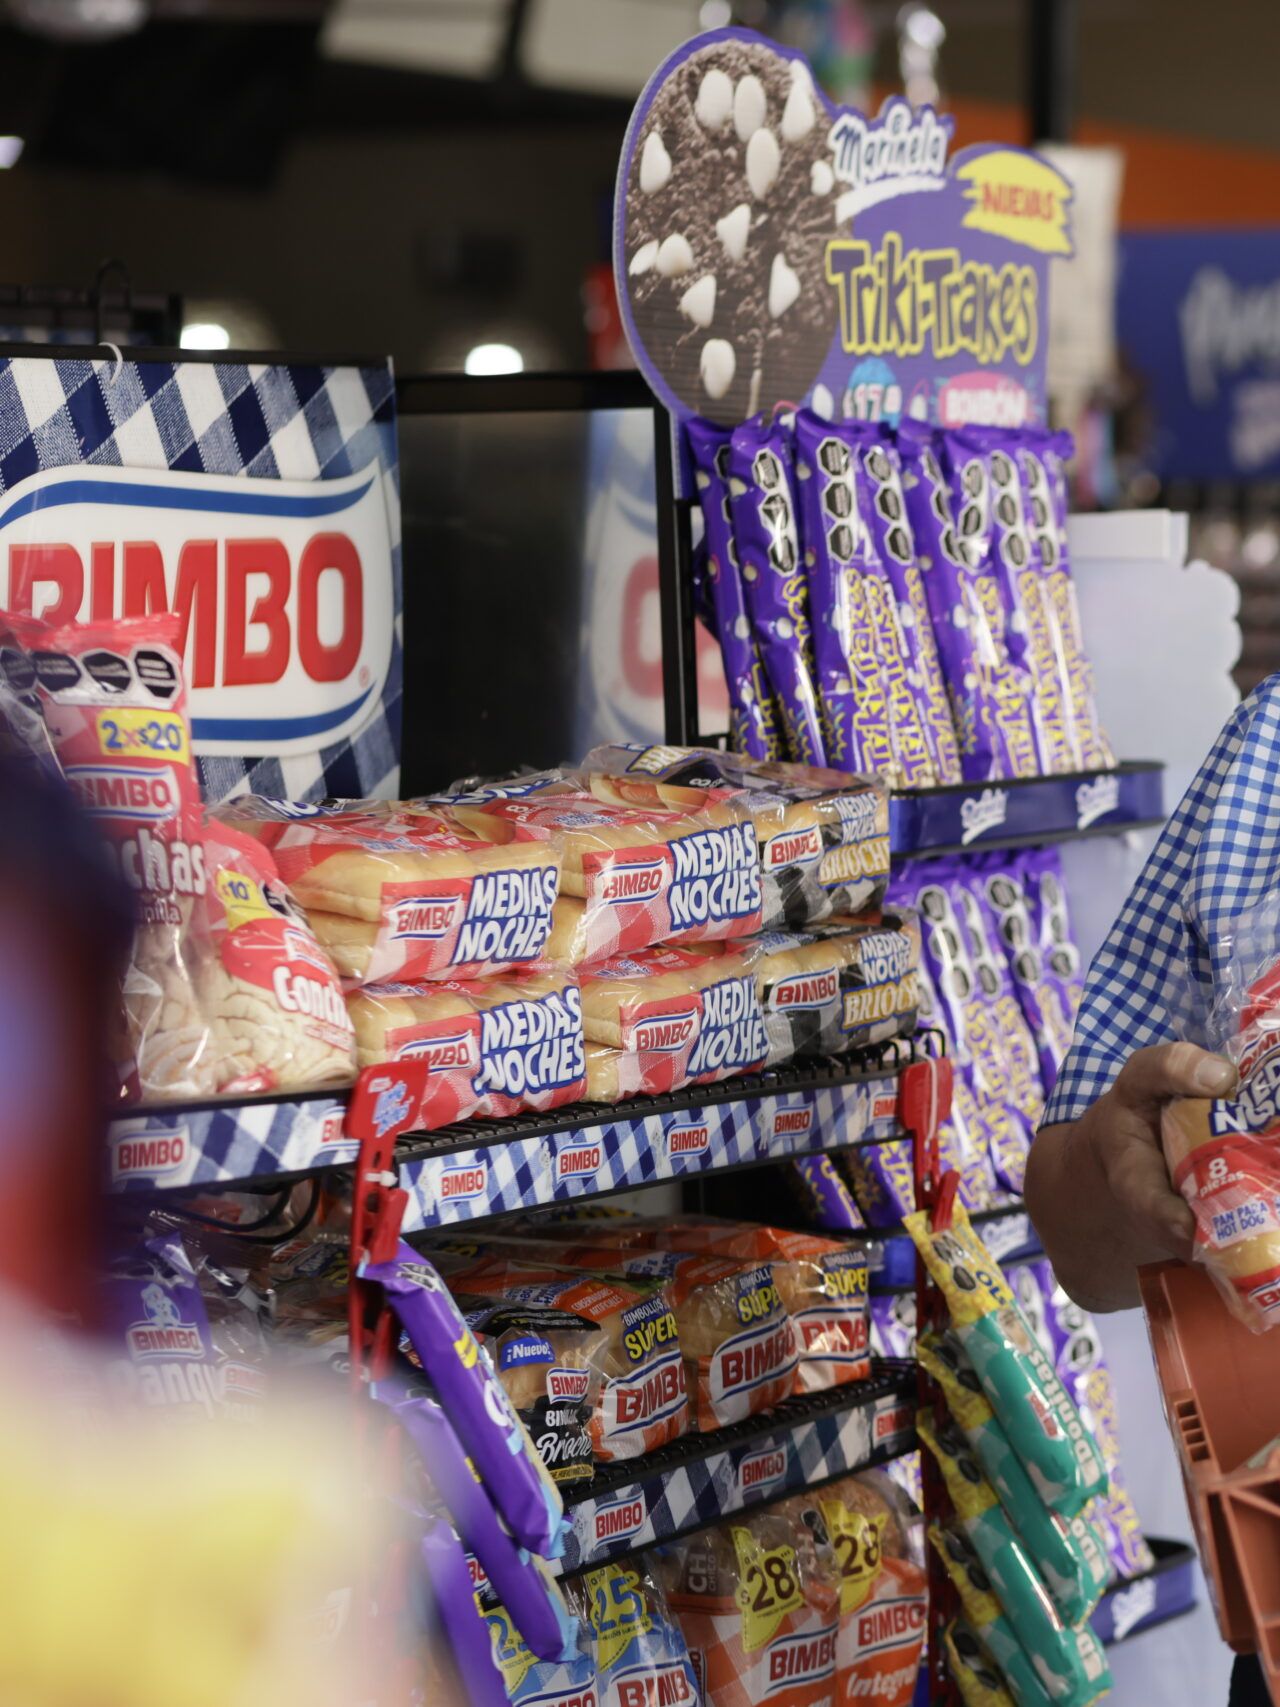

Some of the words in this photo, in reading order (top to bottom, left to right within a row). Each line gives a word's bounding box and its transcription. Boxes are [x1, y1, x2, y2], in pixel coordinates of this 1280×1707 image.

[832, 116, 944, 186] Marinela
[670, 823, 757, 881] MEDIAS
[465, 867, 557, 920] MEDIAS
[602, 868, 662, 899] BIMBO
[669, 868, 762, 931] NOCHES
[397, 905, 456, 932] BIMBO
[273, 966, 355, 1034] Conch
[702, 978, 760, 1031] MEDIA
[776, 974, 837, 1005] BIMBO
[843, 973, 919, 1028] BRIOCH
[482, 987, 582, 1052] MEDIAS
[636, 1019, 694, 1050] BIMBO
[472, 1034, 585, 1096] NOCHES
[774, 1109, 811, 1133] BIMBO
[872, 1093, 898, 1117] BIM
[118, 1138, 184, 1171] BIMBO
[671, 1127, 707, 1152] BIMBO
[560, 1146, 600, 1174] BIMBO
[1208, 1157, 1228, 1180] 8
[440, 1167, 485, 1196] BIMBO
[1200, 1170, 1245, 1198] piezas
[1212, 1211, 1235, 1227] PAN
[1217, 1222, 1238, 1241] HOT
[1240, 1215, 1266, 1231] DOG
[824, 1266, 868, 1298] SÚPE
[132, 1330, 199, 1352] BIMBO
[624, 1311, 679, 1360] SÚPER
[799, 1317, 868, 1352] BIMB
[721, 1323, 796, 1389] BIMBO
[550, 1374, 589, 1396] BIMBO
[743, 1452, 785, 1486] BIMBO
[595, 1502, 643, 1539] BIMBO
[858, 1602, 927, 1647] BIMBO
[617, 1669, 690, 1707] BIMB
